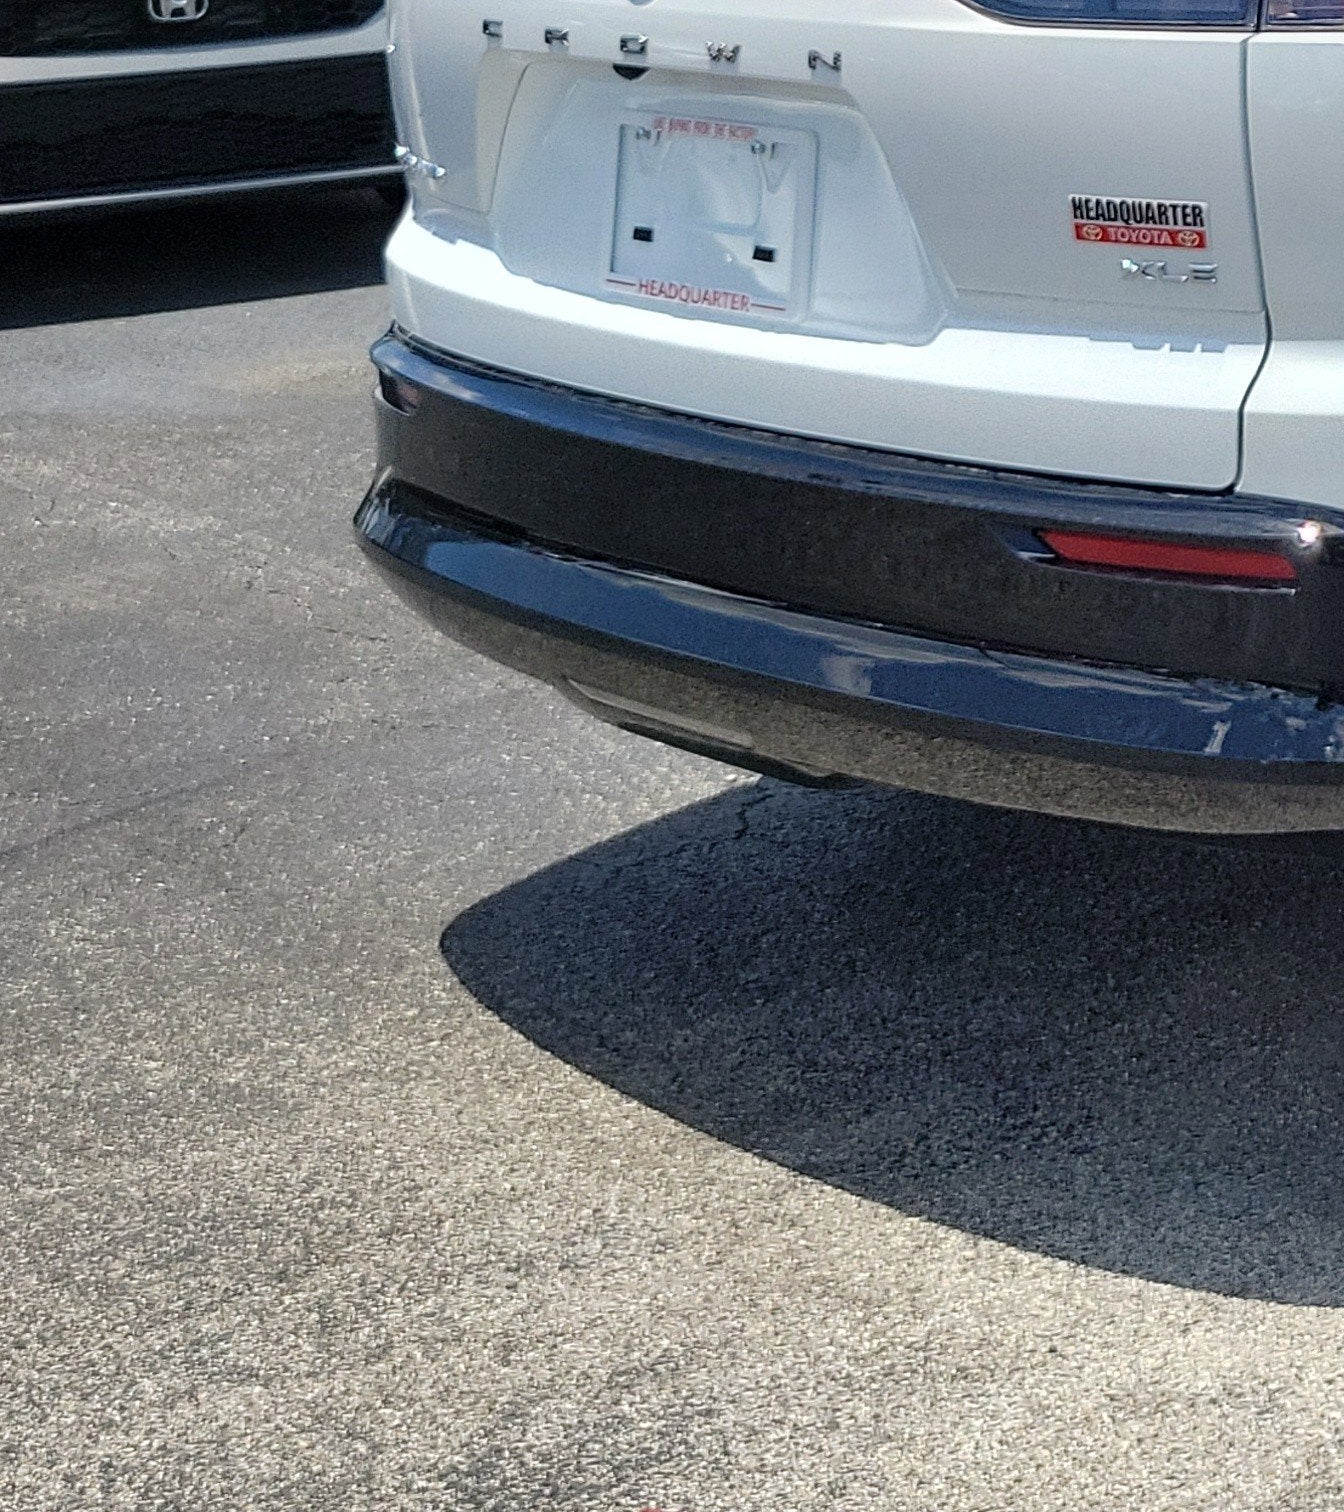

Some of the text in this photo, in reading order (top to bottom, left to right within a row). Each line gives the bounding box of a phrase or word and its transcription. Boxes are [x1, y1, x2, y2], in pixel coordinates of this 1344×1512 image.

[482, 18, 842, 72] CROWN
[1071, 196, 1205, 228] HEADQUARTER
[1107, 228, 1173, 245] TOYOTA
[1120, 258, 1219, 285] XLE
[638, 278, 750, 312] HEADQUARTER
